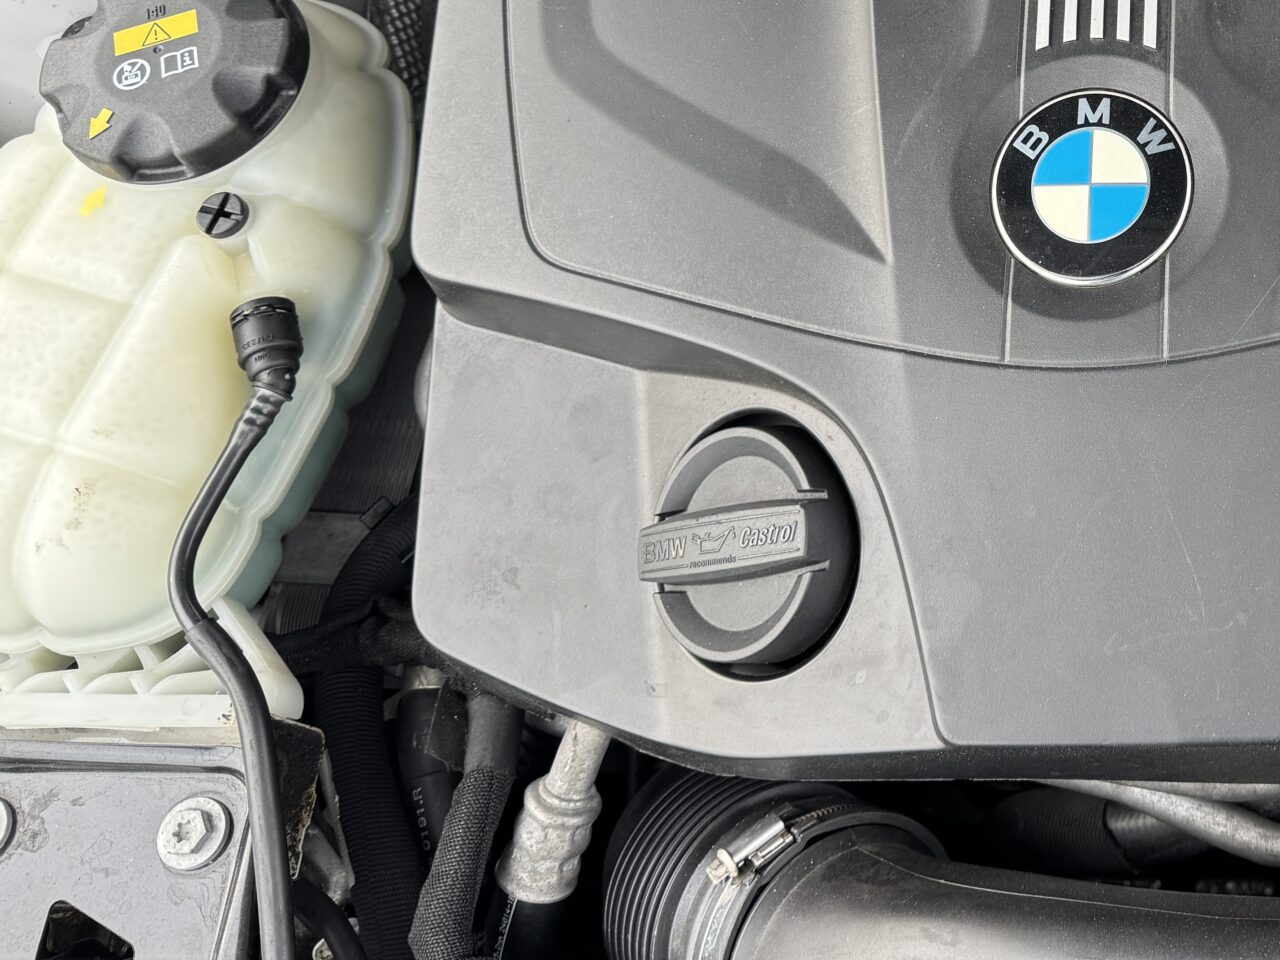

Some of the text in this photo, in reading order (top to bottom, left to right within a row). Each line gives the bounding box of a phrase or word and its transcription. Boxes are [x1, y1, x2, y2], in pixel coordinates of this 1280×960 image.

[1012, 96, 1177, 161] BMW
[643, 520, 799, 565] BMW Castrol
[689, 553, 737, 569] recommends
